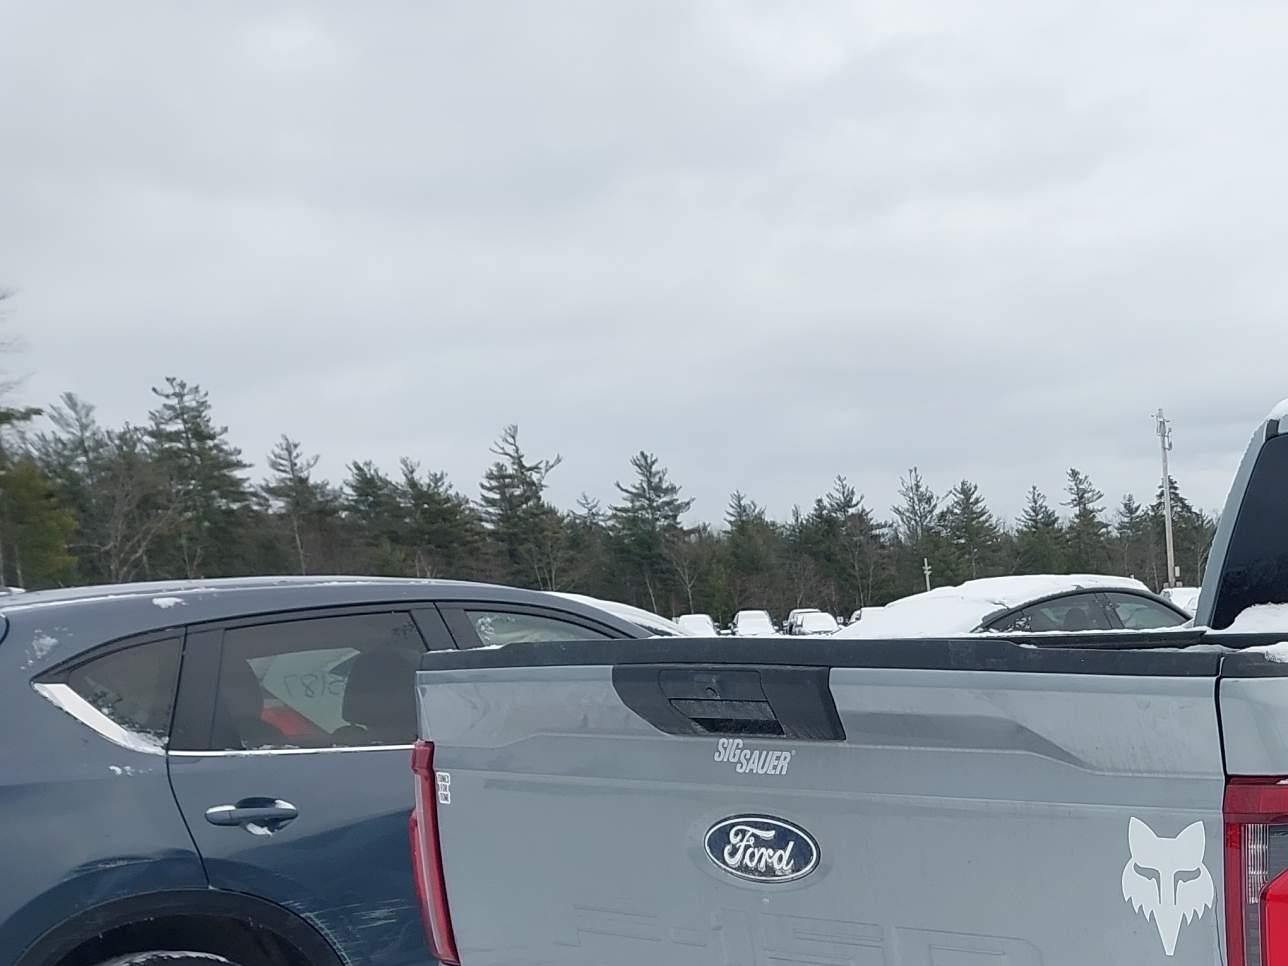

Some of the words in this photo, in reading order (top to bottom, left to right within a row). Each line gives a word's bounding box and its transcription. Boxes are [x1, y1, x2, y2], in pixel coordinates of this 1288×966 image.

[714, 737, 744, 763] SIG
[735, 748, 793, 776] SAUER
[724, 824, 795, 872] Ford
